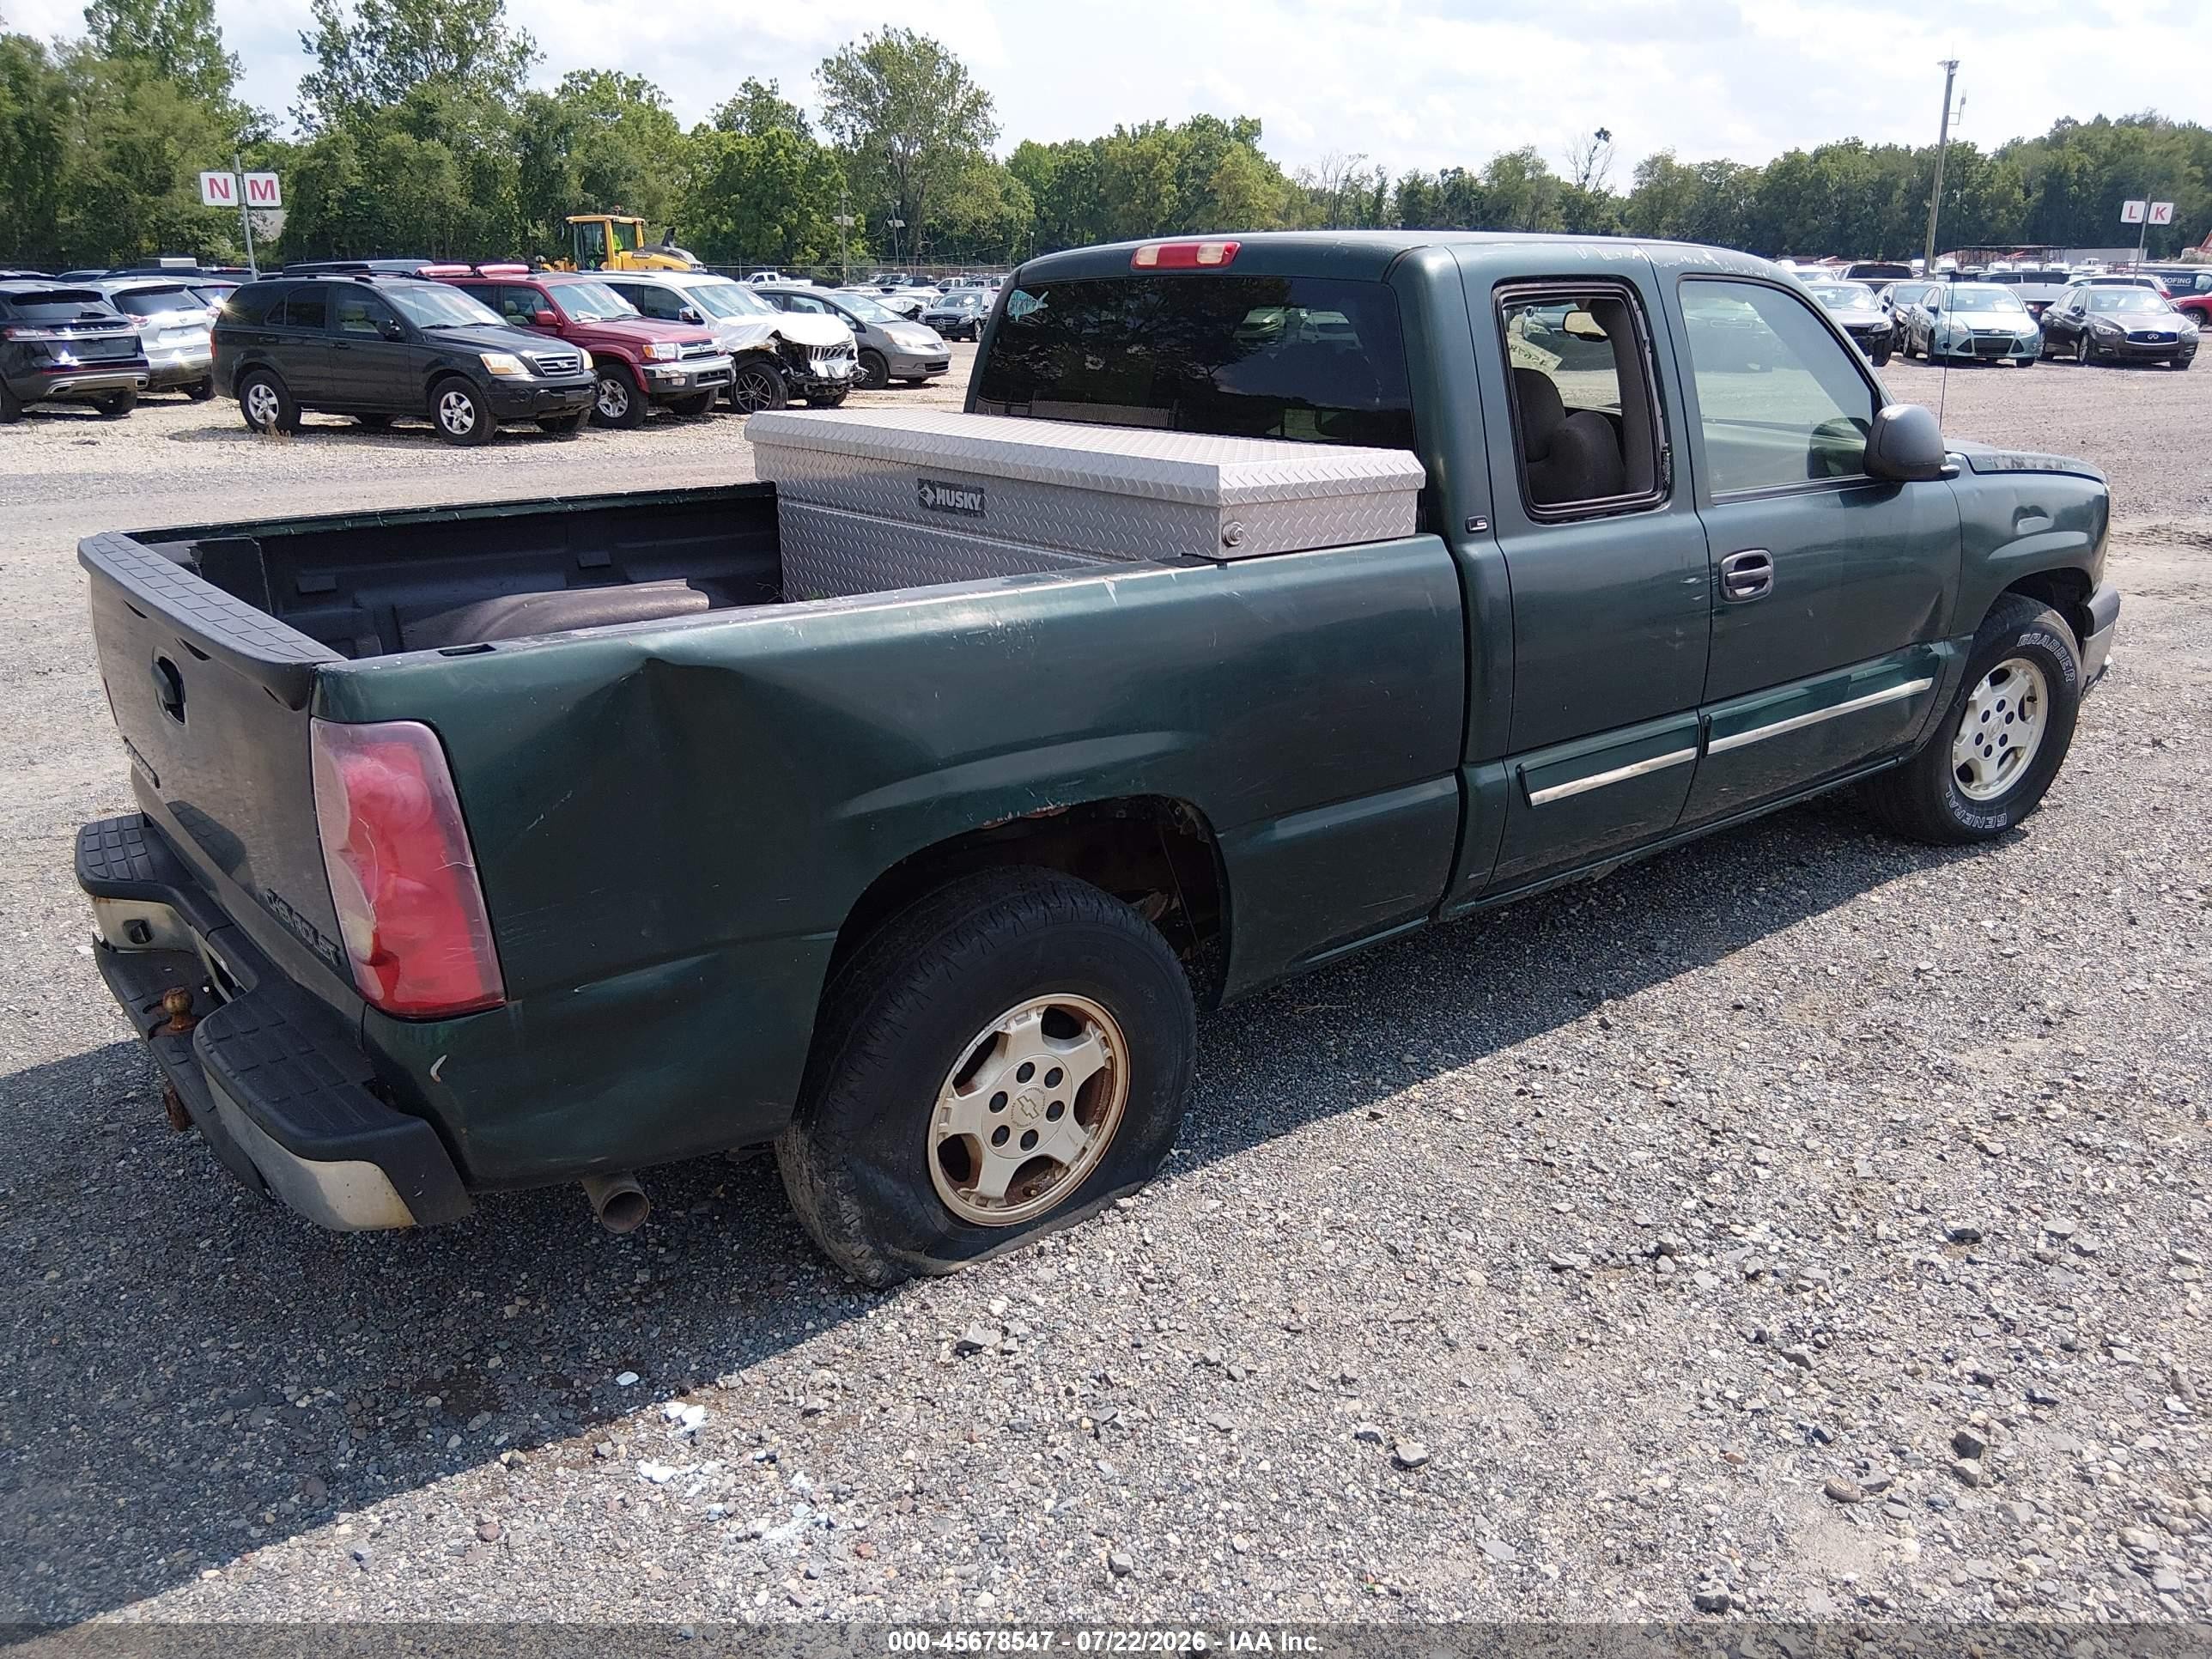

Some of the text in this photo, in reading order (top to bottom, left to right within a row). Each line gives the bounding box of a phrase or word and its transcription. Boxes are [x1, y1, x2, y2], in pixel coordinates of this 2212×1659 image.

[209, 178, 230, 199] N
[249, 179, 276, 201] M
[2128, 205, 2137, 219] L
[2154, 207, 2167, 221] K
[936, 487, 981, 511] HUSKY
[1468, 519, 1488, 531] LS
[2016, 633, 2075, 683] GRABBER
[1945, 783, 2008, 830] GENERAL
